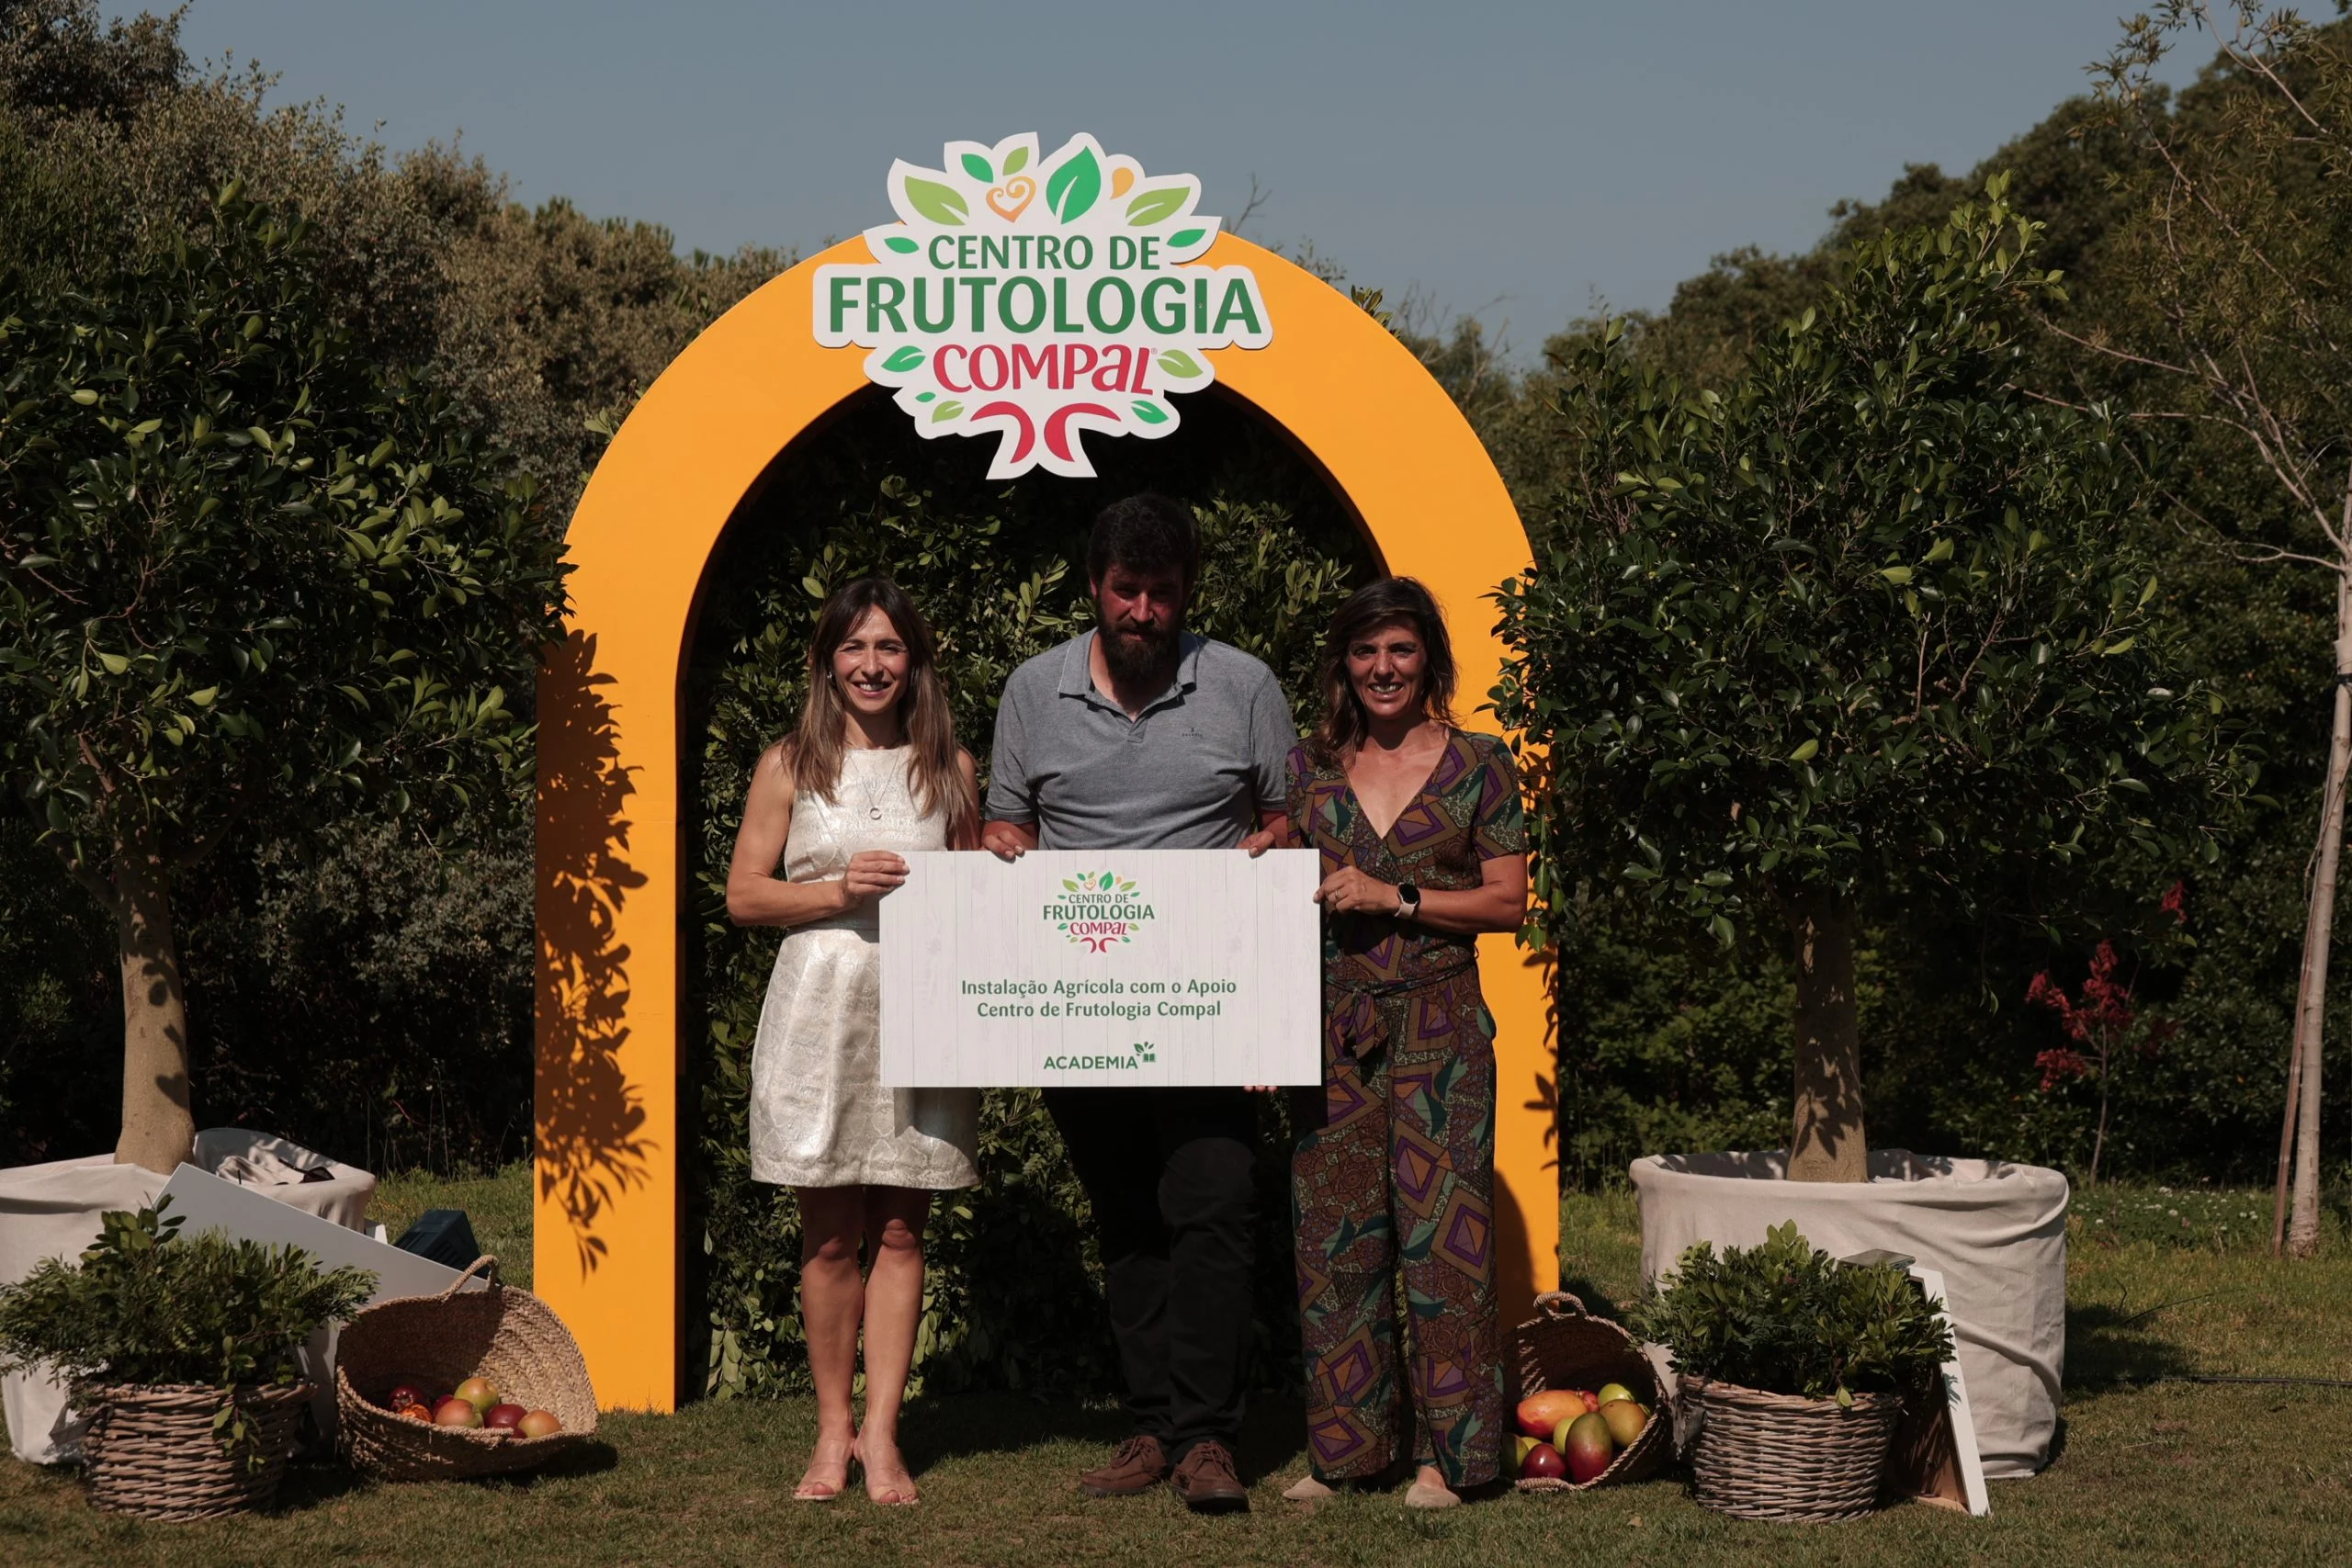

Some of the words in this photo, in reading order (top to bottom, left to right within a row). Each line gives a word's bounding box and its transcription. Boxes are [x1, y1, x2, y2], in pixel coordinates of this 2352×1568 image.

[928, 235, 1093, 270] CENTRO
[1109, 235, 1160, 270] DE
[830, 276, 1262, 334] FRUTOLOGIA
[1069, 894, 1112, 904] CENTRO
[1114, 894, 1129, 904] DE
[1043, 904, 1155, 920] FRUTOLOGIA
[961, 979, 1047, 998] Instalação
[1053, 978, 1125, 999] Agrícola
[1129, 982, 1166, 994] com
[1170, 982, 1182, 994] o
[1187, 979, 1237, 998] Apoio
[977, 1002, 1035, 1018] Centro
[1039, 1000, 1060, 1018] de
[1066, 1000, 1151, 1021] Frutologia
[1157, 999, 1221, 1021] Compal
[1043, 1055, 1138, 1070] ACADEMIA
